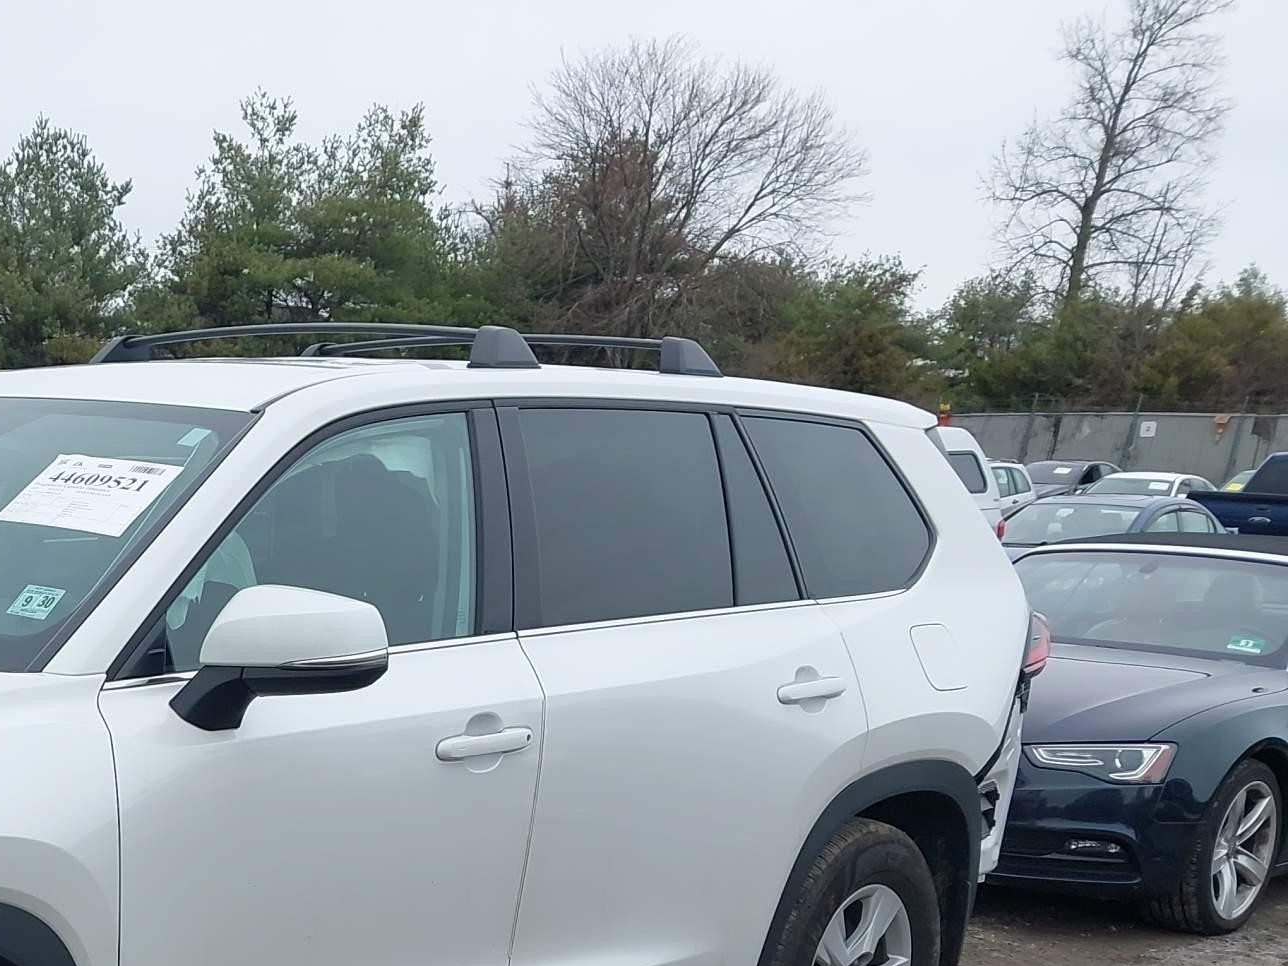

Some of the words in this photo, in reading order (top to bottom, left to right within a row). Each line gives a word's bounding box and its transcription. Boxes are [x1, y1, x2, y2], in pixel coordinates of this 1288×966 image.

[48, 470, 149, 492] 44609521
[22, 595, 33, 607] 9
[37, 595, 56, 609] 30
